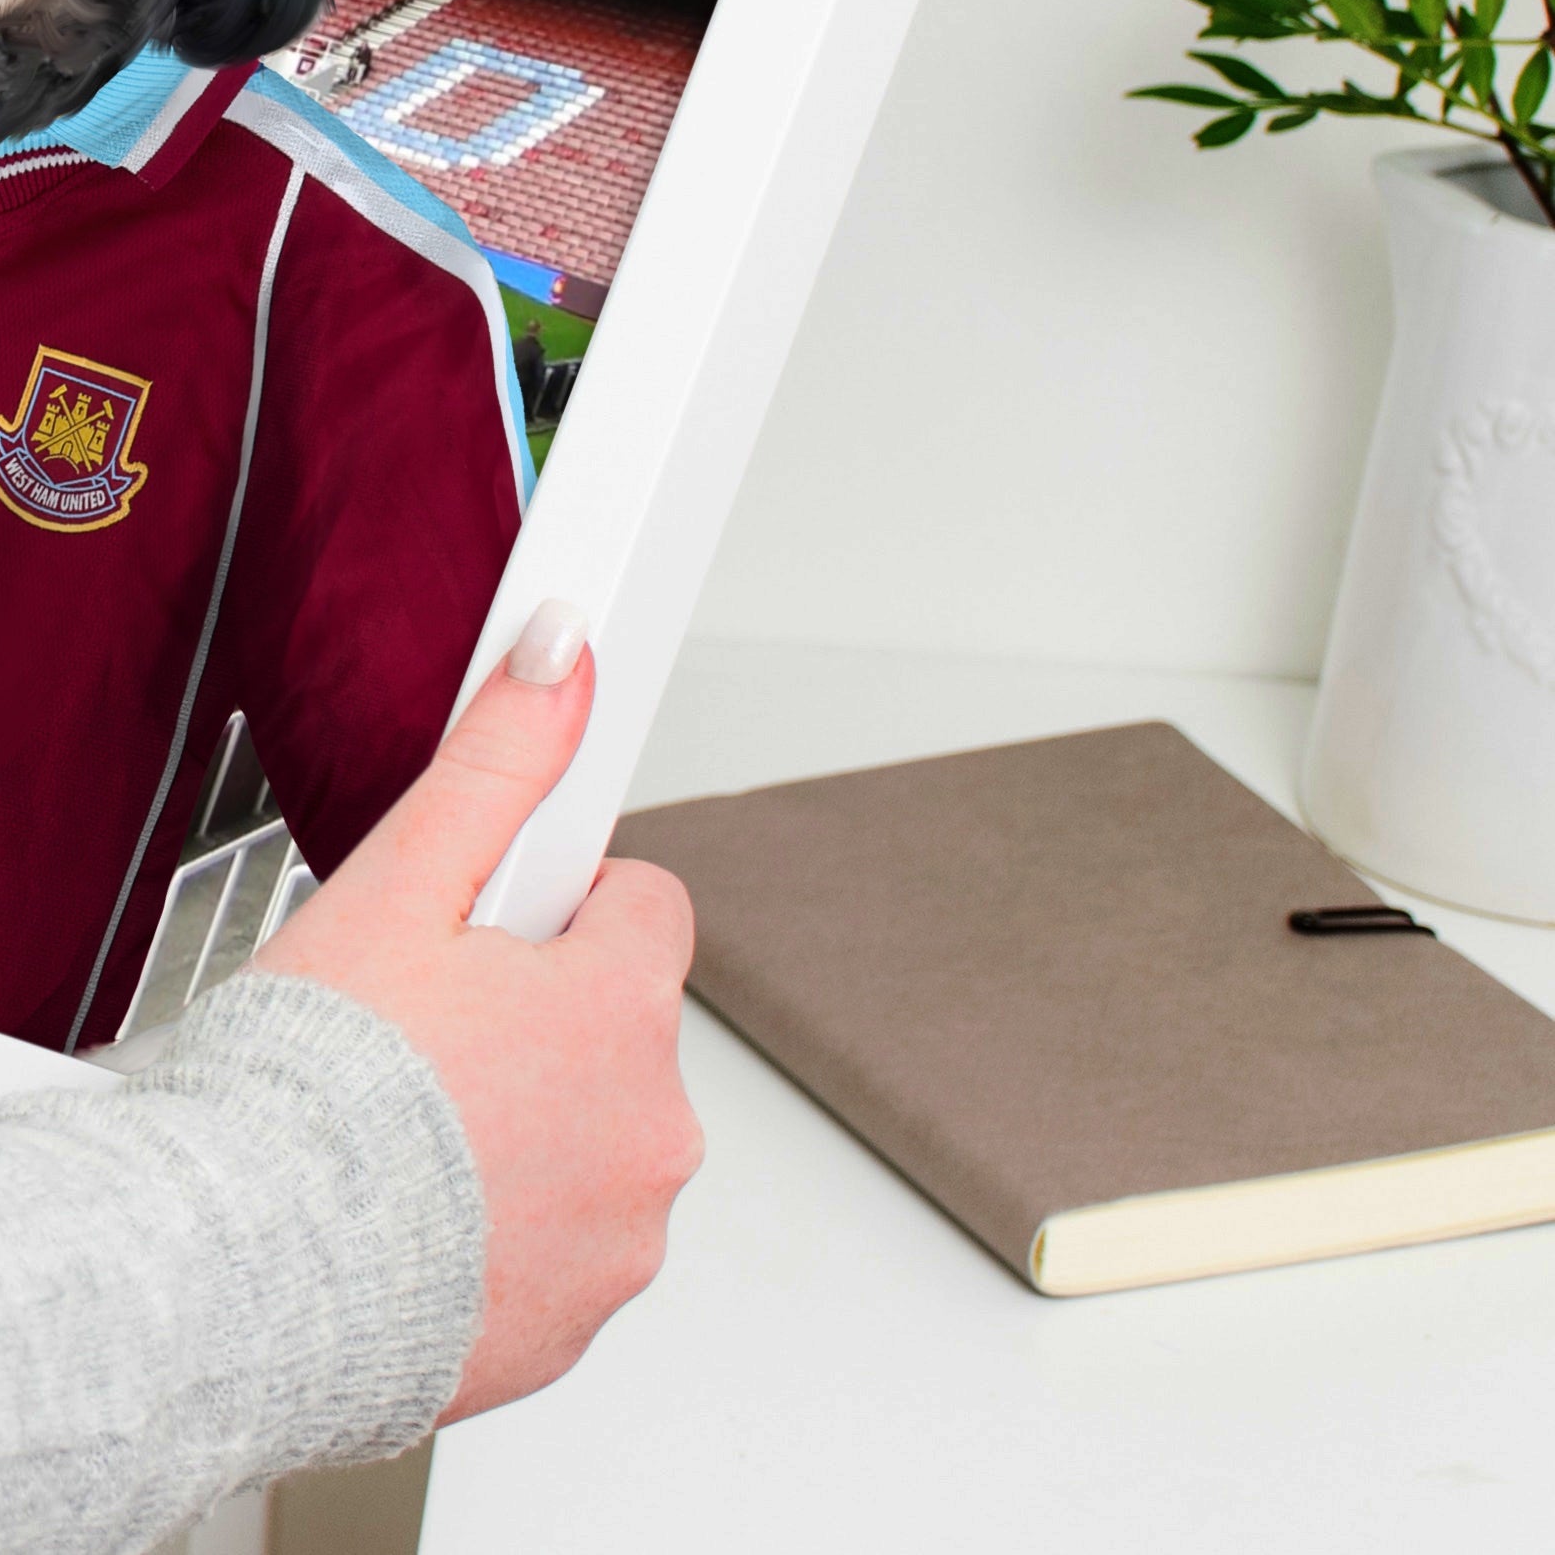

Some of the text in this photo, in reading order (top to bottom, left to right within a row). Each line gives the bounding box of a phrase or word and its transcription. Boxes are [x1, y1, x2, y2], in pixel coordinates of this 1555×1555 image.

[4, 457, 106, 512] WEST HAM UNITED
